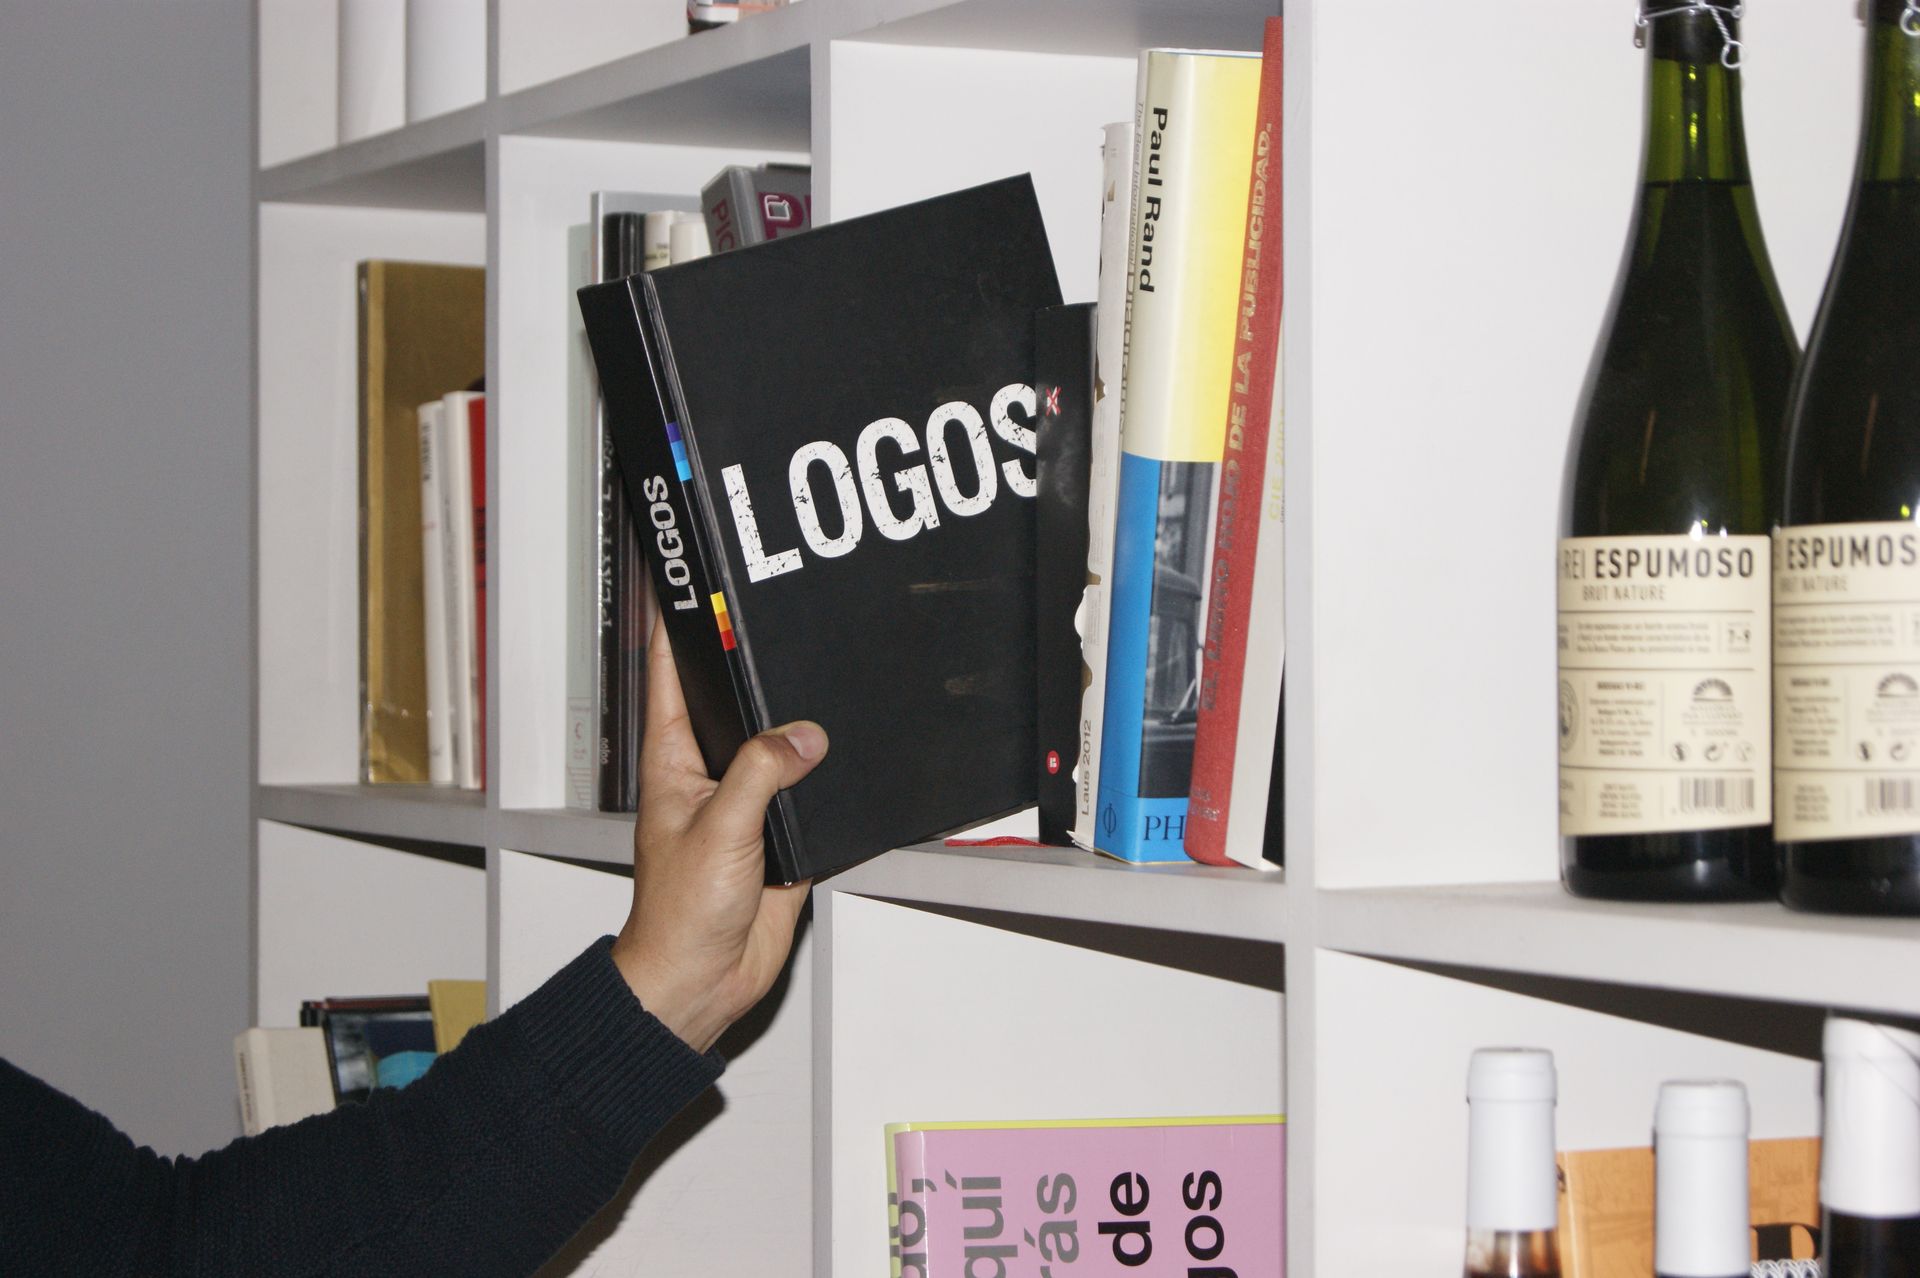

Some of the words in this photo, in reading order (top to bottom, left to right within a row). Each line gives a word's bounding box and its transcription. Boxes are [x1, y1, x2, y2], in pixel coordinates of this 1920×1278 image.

[1148, 107, 1168, 186] Paul
[1140, 196, 1161, 292] Rand
[1235, 352, 1252, 395] LA
[1228, 402, 1247, 451] DE
[643, 475, 698, 610] LOGOS
[1594, 547, 1754, 579] ESPUMOSO
[1582, 585, 1608, 601] BRUT
[1614, 585, 1666, 601] NATURE
[1083, 719, 1091, 767] 2012
[1082, 771, 1090, 816] Laus
[1098, 1172, 1152, 1266] de
